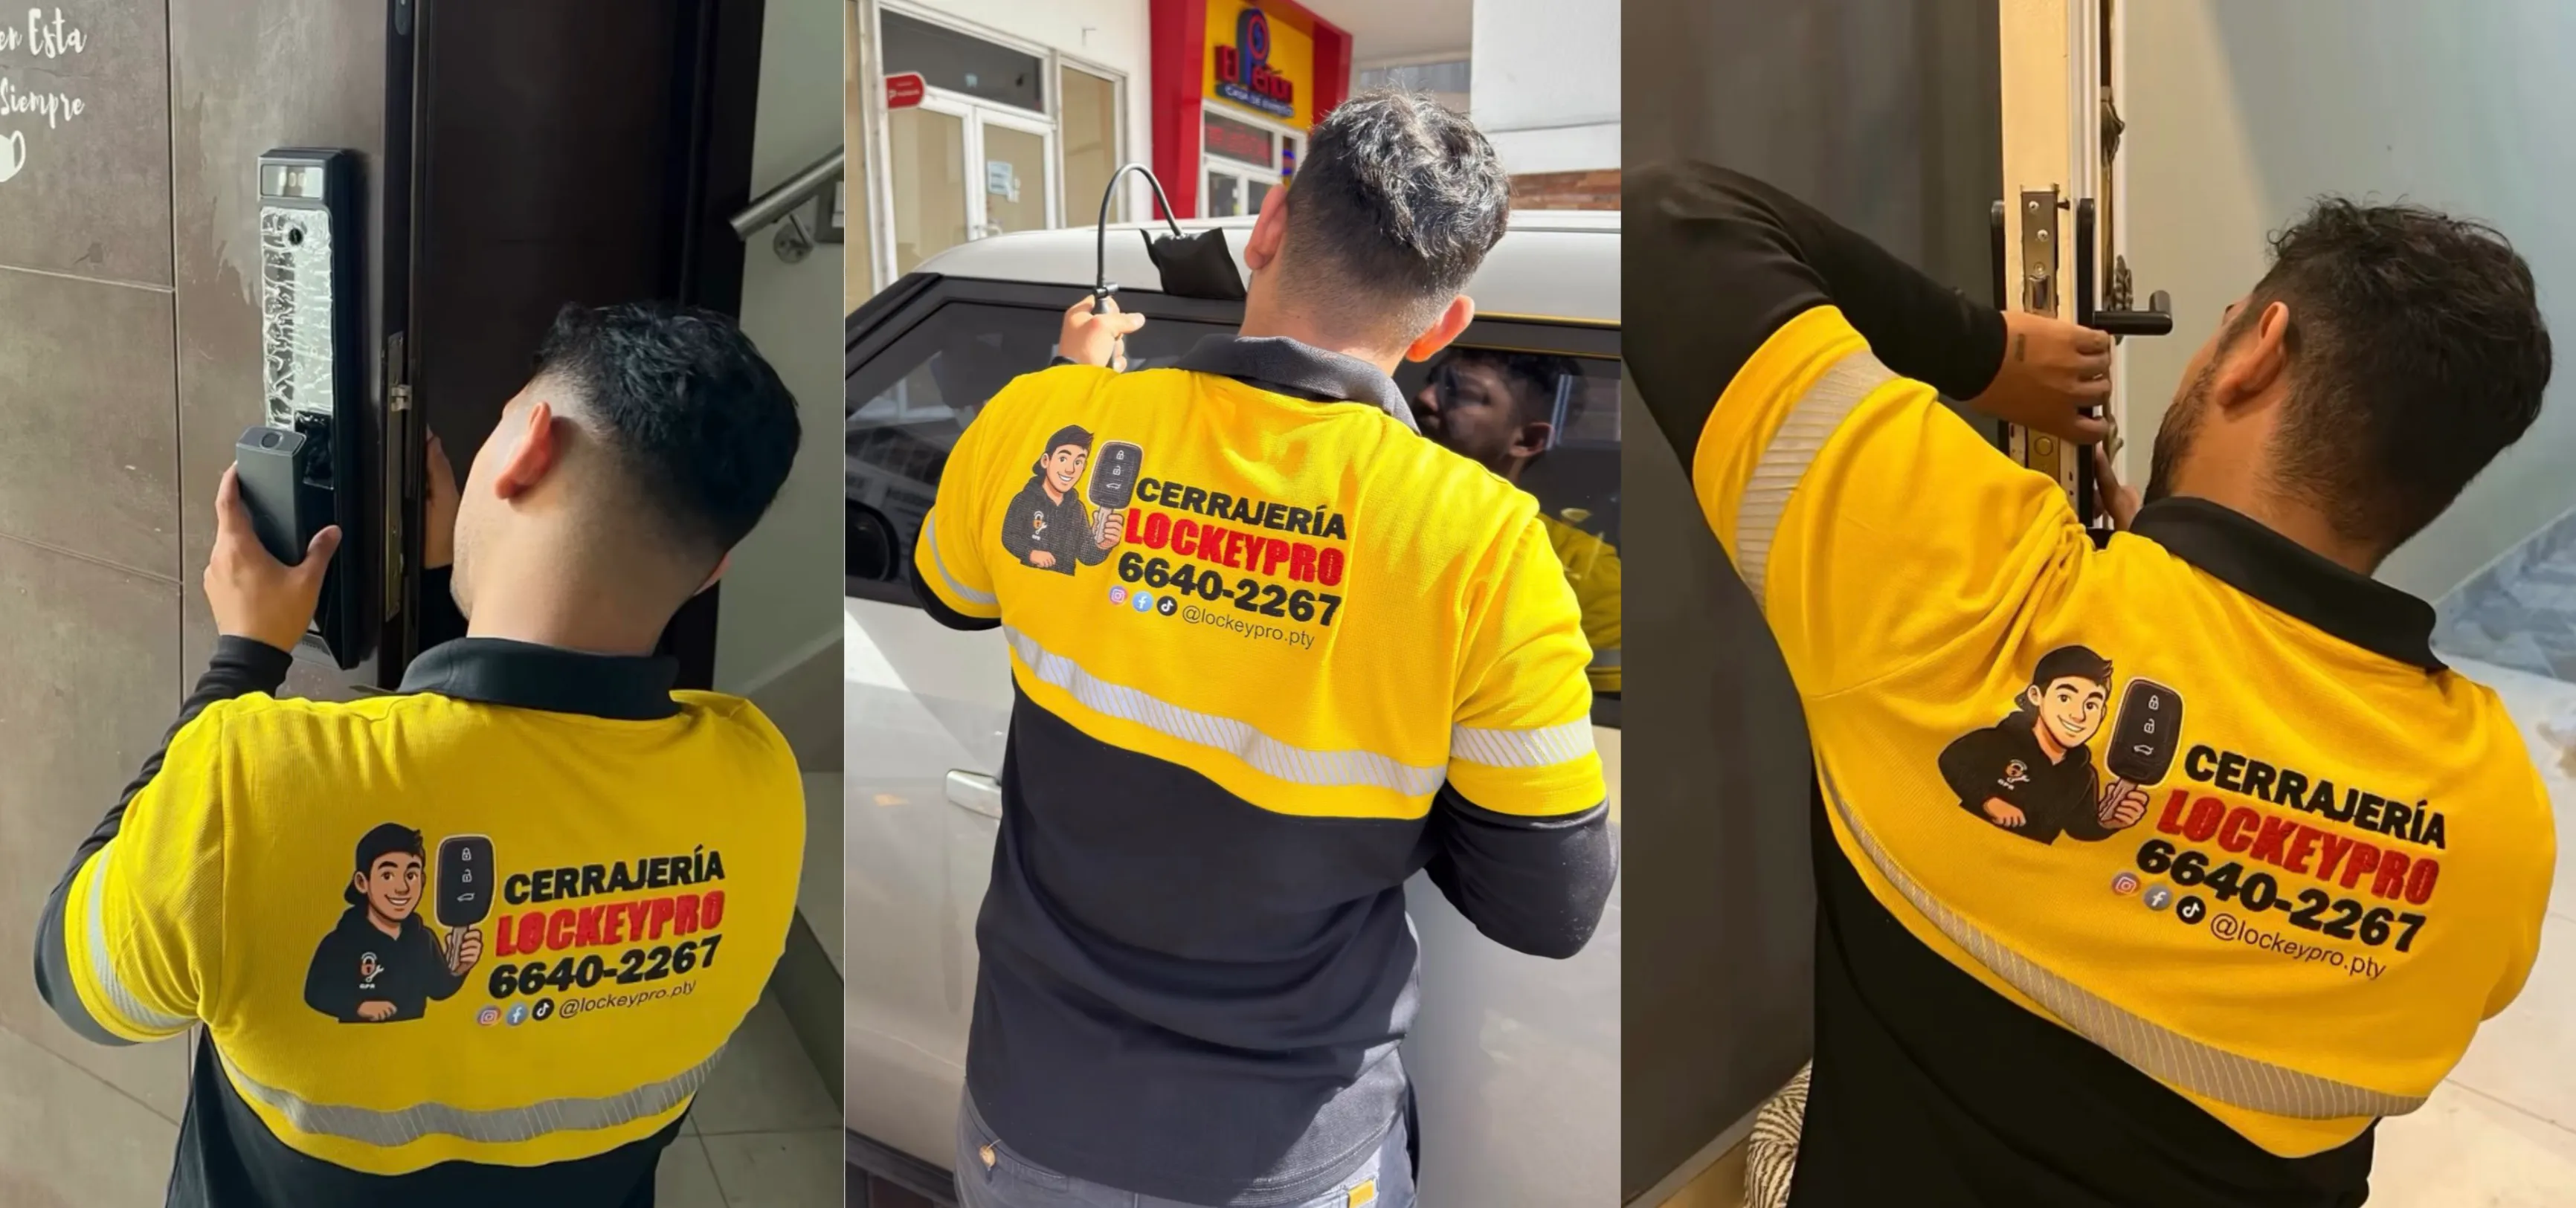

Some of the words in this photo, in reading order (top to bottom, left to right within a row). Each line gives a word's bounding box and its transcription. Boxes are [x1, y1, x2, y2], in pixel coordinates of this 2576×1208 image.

[28, 7, 87, 59] Esta
[0, 77, 85, 129] Siempre
[1136, 478, 1347, 540] CERRAJERÍA
[1124, 508, 1345, 587] LOCKEYPRO
[1118, 552, 1342, 626] 6640-2267
[1182, 605, 1315, 649] @lockeypro.pty
[2185, 745, 2446, 849] CERRAJERÍA
[504, 844, 725, 905] CERRAJERÍA
[2157, 789, 2439, 905] LOCKEYPRO
[496, 890, 725, 957] LOCKEYPRO
[2137, 839, 2426, 952] 6640-2267
[489, 934, 722, 999] 6640-2267
[2211, 913, 2386, 979] @lockeypro.pty
[559, 981, 696, 1018] @lockeypro.pty
